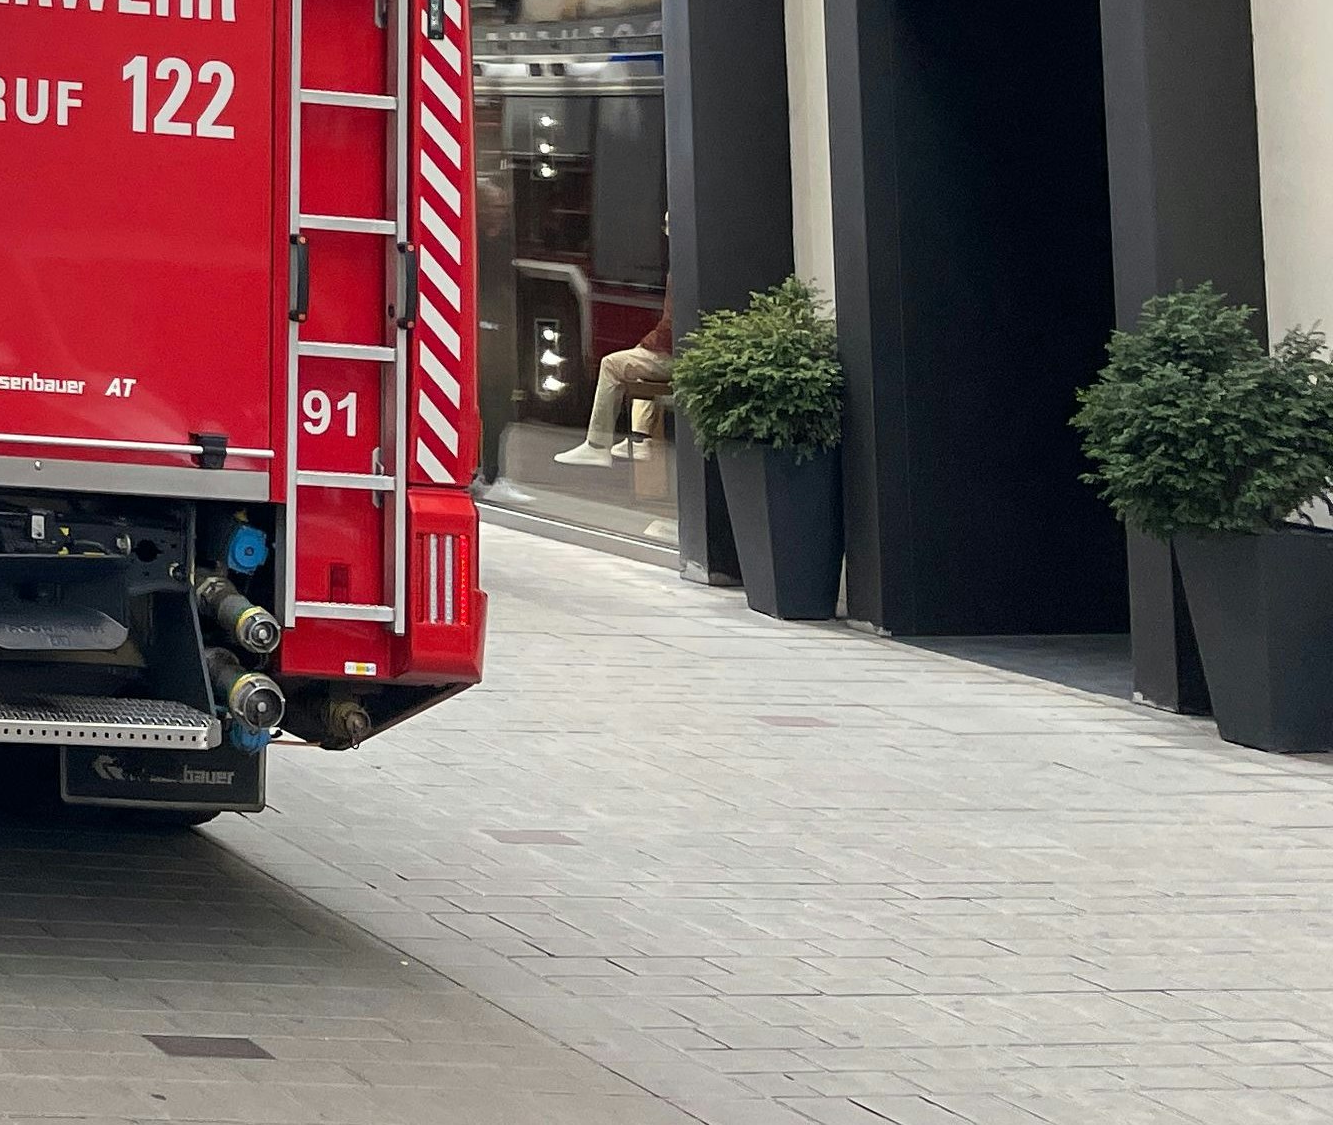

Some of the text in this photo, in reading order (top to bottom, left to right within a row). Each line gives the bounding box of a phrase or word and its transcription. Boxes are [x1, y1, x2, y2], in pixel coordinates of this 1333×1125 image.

[122, 55, 236, 139] 122
[105, 378, 137, 398] AT
[302, 389, 358, 438] 91
